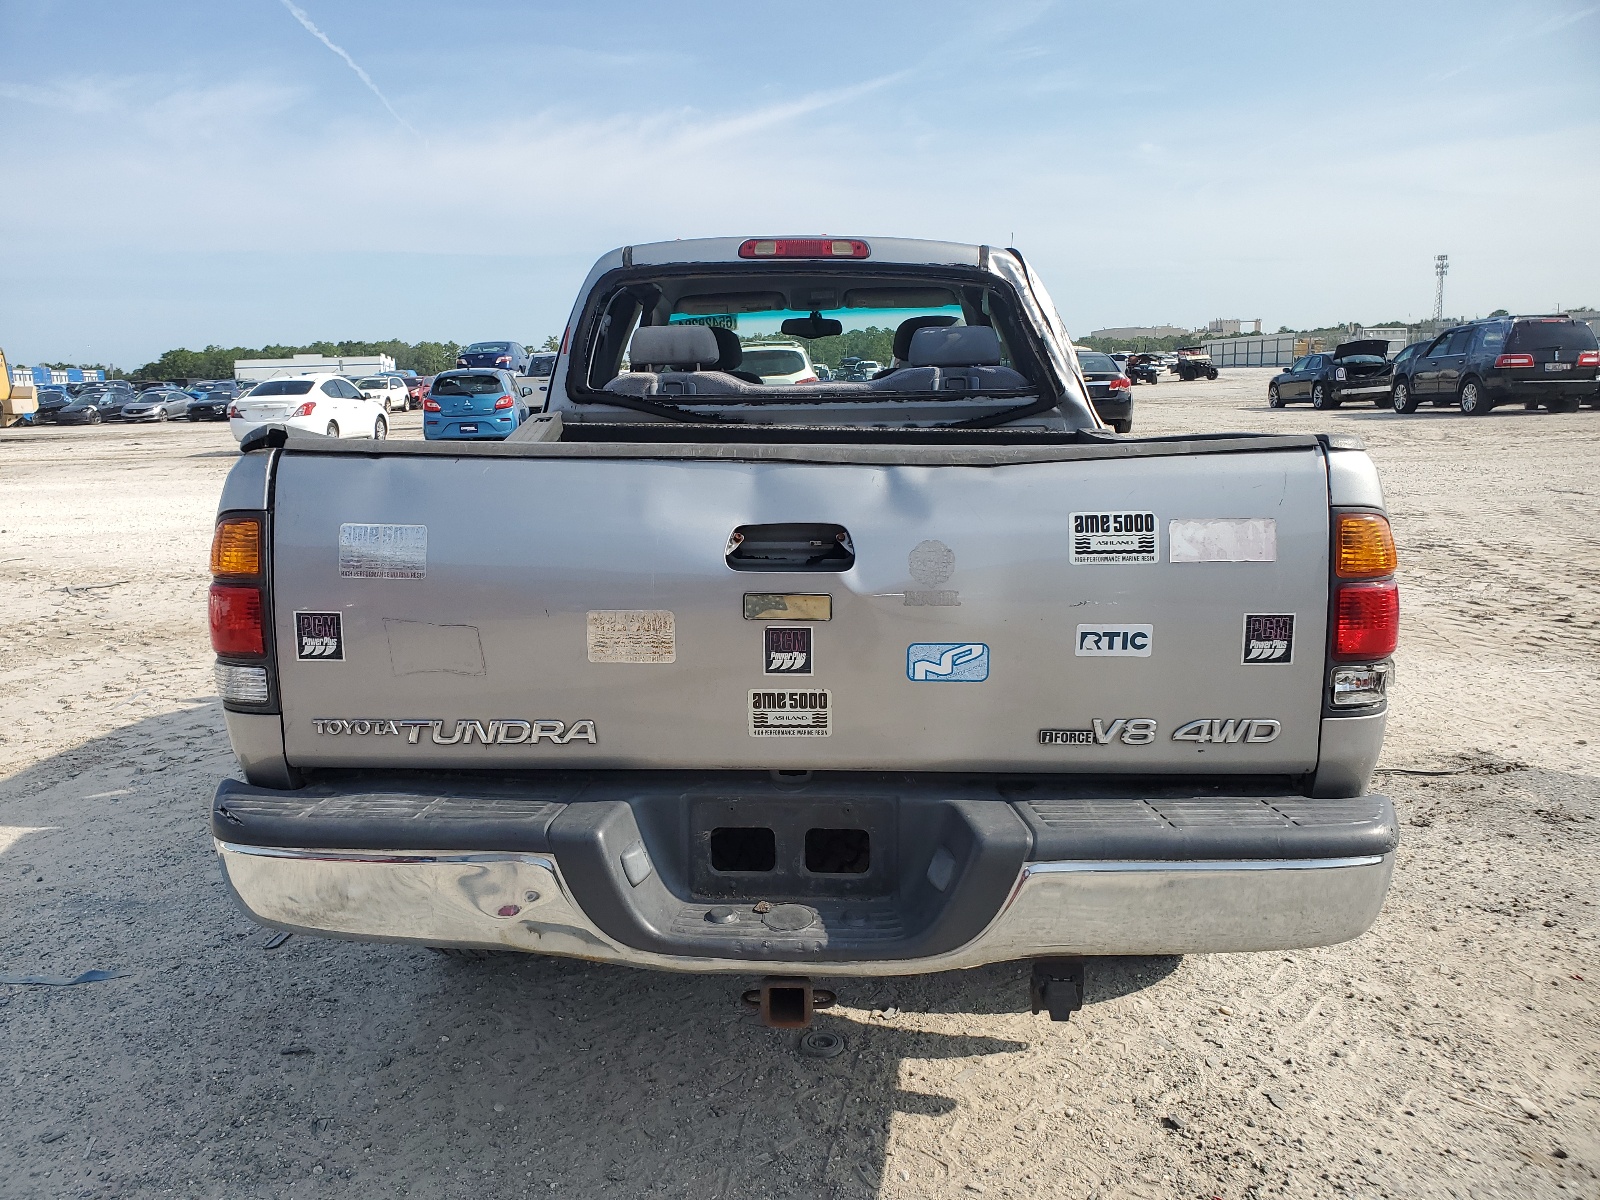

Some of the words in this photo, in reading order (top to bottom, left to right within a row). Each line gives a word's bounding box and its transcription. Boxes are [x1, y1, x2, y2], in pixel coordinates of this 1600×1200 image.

[1074, 514, 1110, 533] ame
[1113, 513, 1155, 532] 5000
[301, 615, 338, 637] PCM
[1250, 617, 1290, 640] PCM
[769, 630, 807, 651] PCM
[1079, 631, 1149, 651] RTIC
[752, 692, 787, 709] ame
[788, 692, 828, 709] 5000
[311, 718, 399, 735] TOYOTA
[399, 719, 597, 745] TUNDRA
[1092, 718, 1158, 745] V8
[1171, 718, 1282, 744] 4WD
